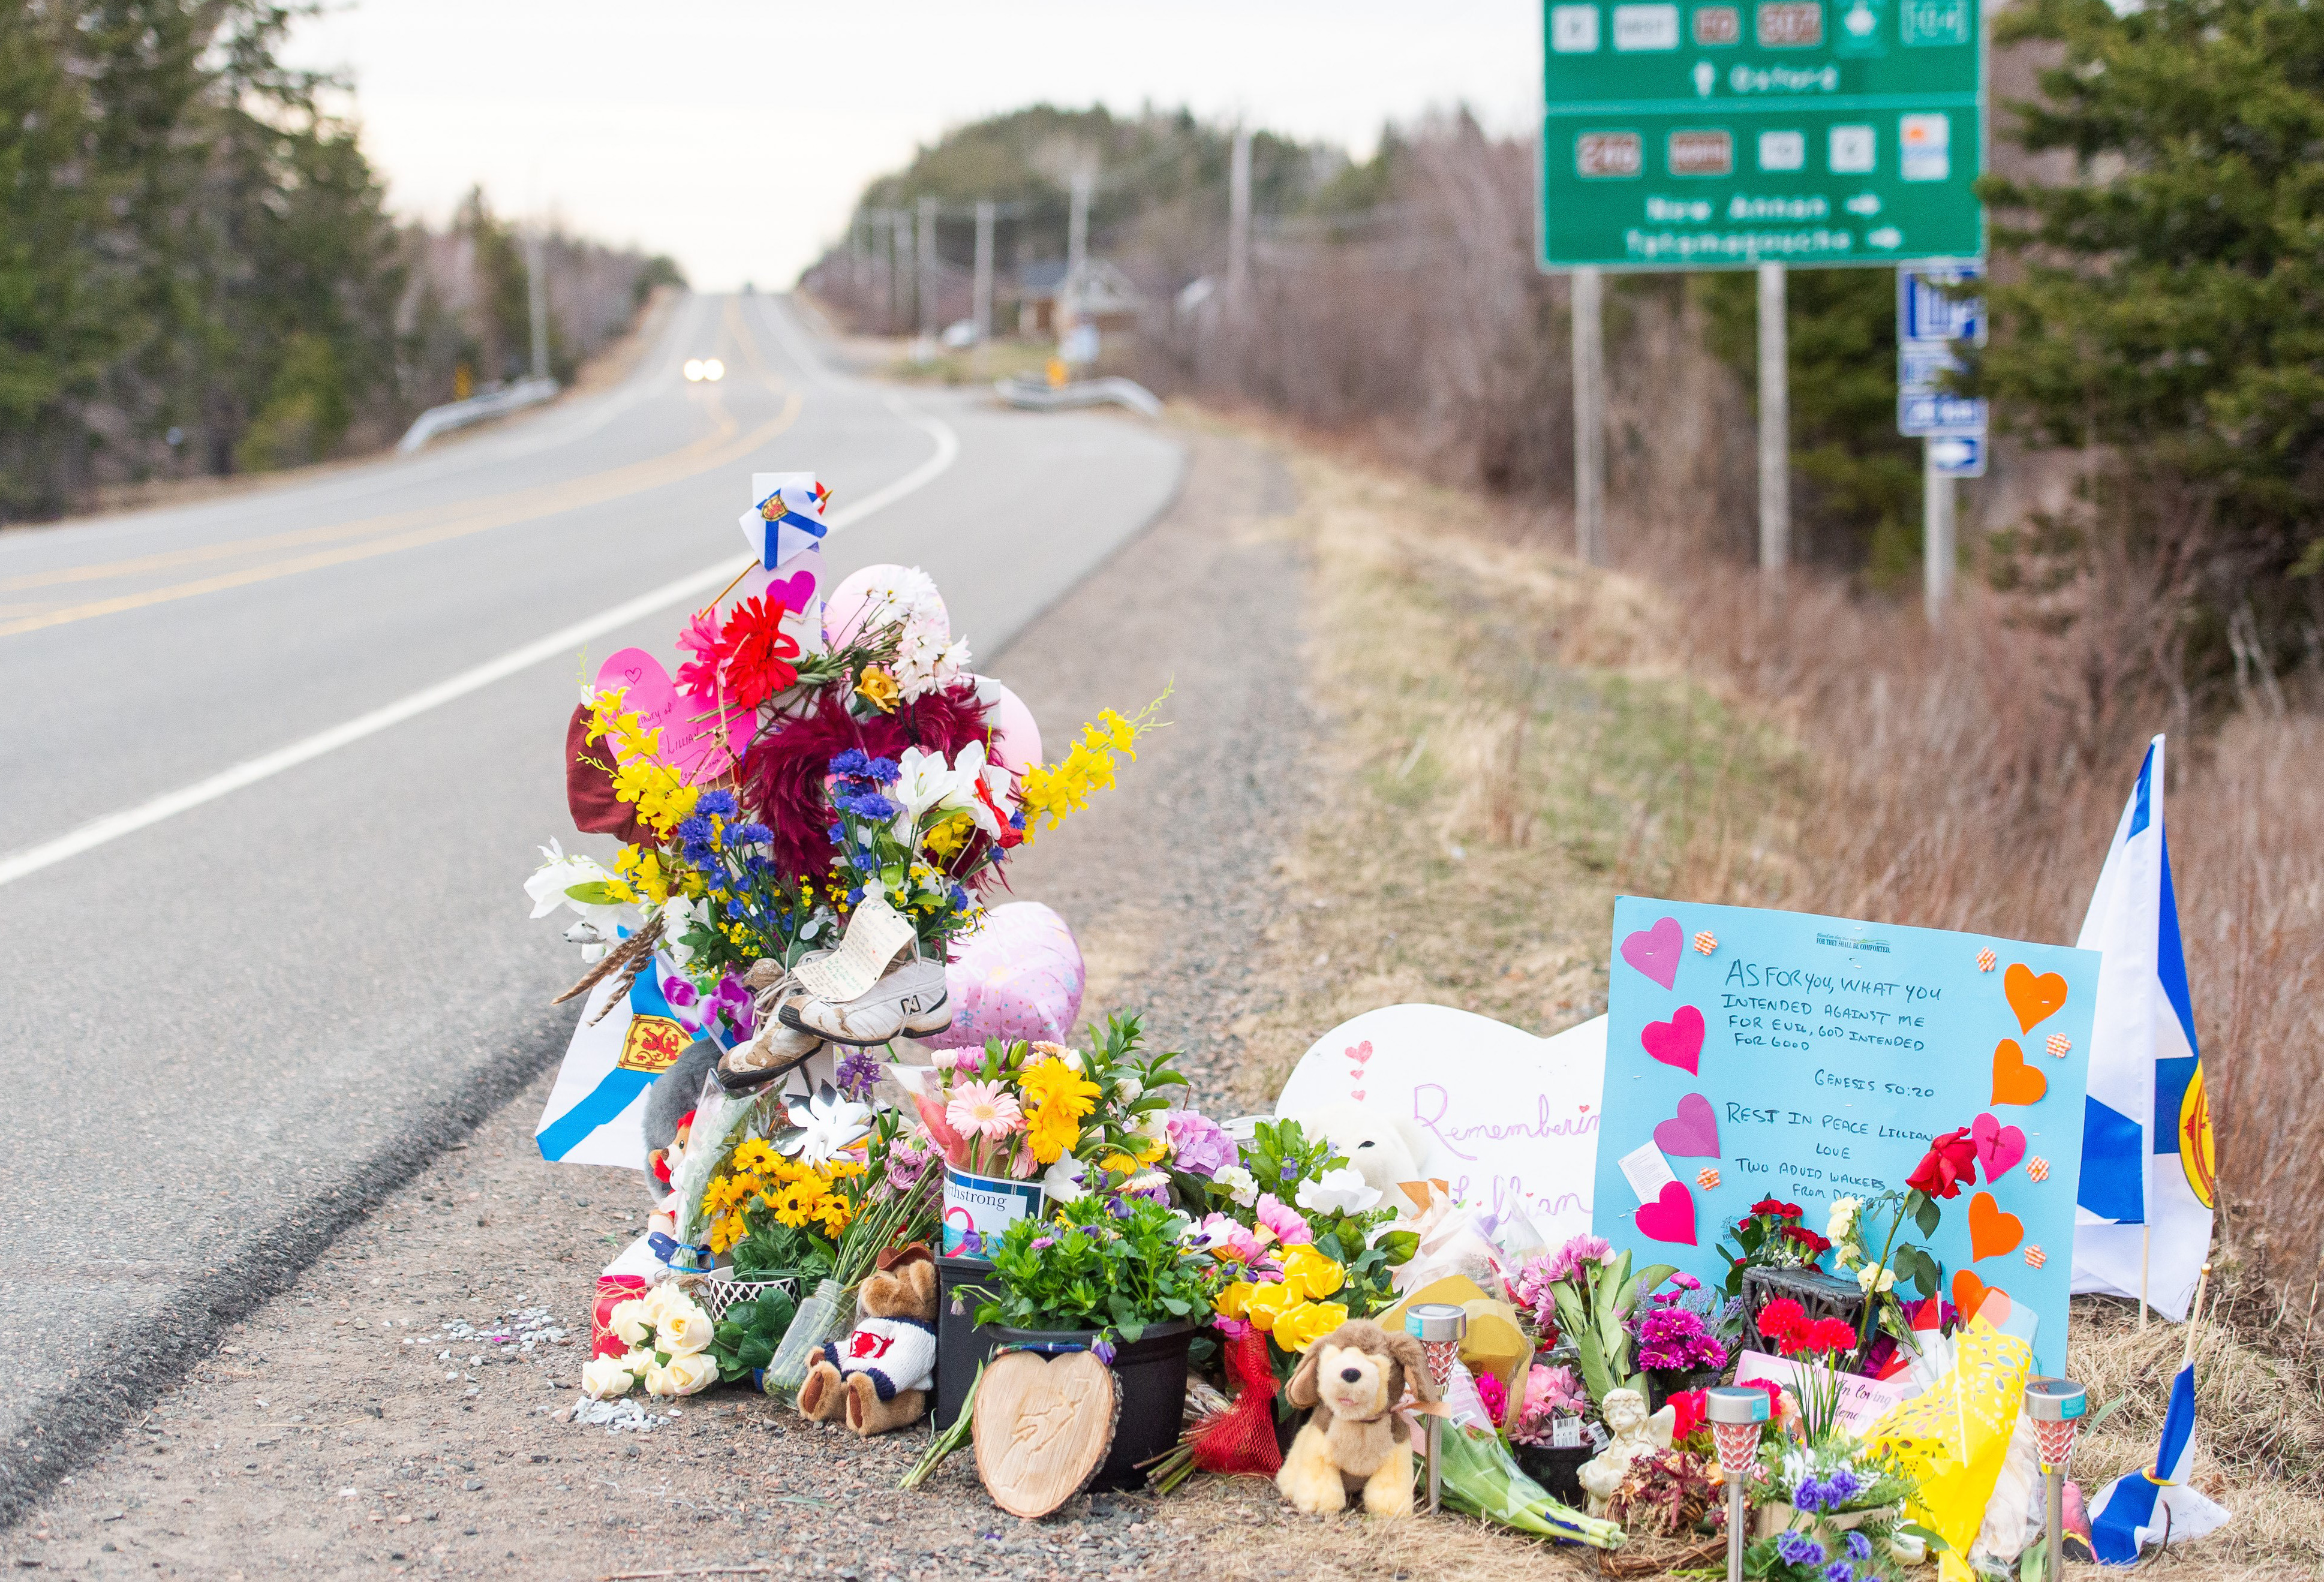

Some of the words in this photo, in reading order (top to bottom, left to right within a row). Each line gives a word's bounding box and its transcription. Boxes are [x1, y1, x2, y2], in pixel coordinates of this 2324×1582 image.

[1730, 65, 1839, 92] Oxford
[1646, 197, 1712, 222] New
[1729, 195, 1829, 222] Annan
[1860, 943, 1891, 953] COMFORTED.
[1725, 958, 1760, 988] AS
[1765, 967, 1802, 988] FOR
[1841, 977, 1901, 996] WHAT
[1721, 994, 1812, 1015] INTENDED
[1824, 1004, 1891, 1025] AGAINST
[1898, 1015, 1925, 1027] ME
[1729, 1015, 1762, 1029] FOR
[1818, 1025, 1844, 1037] GOD
[1849, 1031, 1925, 1051] INTENDED
[1734, 1032, 1767, 1046] FOR
[1771, 1036, 1809, 1051] GOOD
[1814, 1069, 1875, 1091] GENESIS
[1884, 1083, 1935, 1097] 50:20
[1725, 1102, 1780, 1124] REST
[1788, 1111, 1812, 1125] IN
[1822, 1114, 1869, 1135] PEACE
[1878, 1125, 1935, 1142] LILLIAN
[1815, 1142, 1851, 1159] LOVE
[1735, 1157, 1769, 1174] TWO
[1792, 1183, 1826, 1199] FROM
